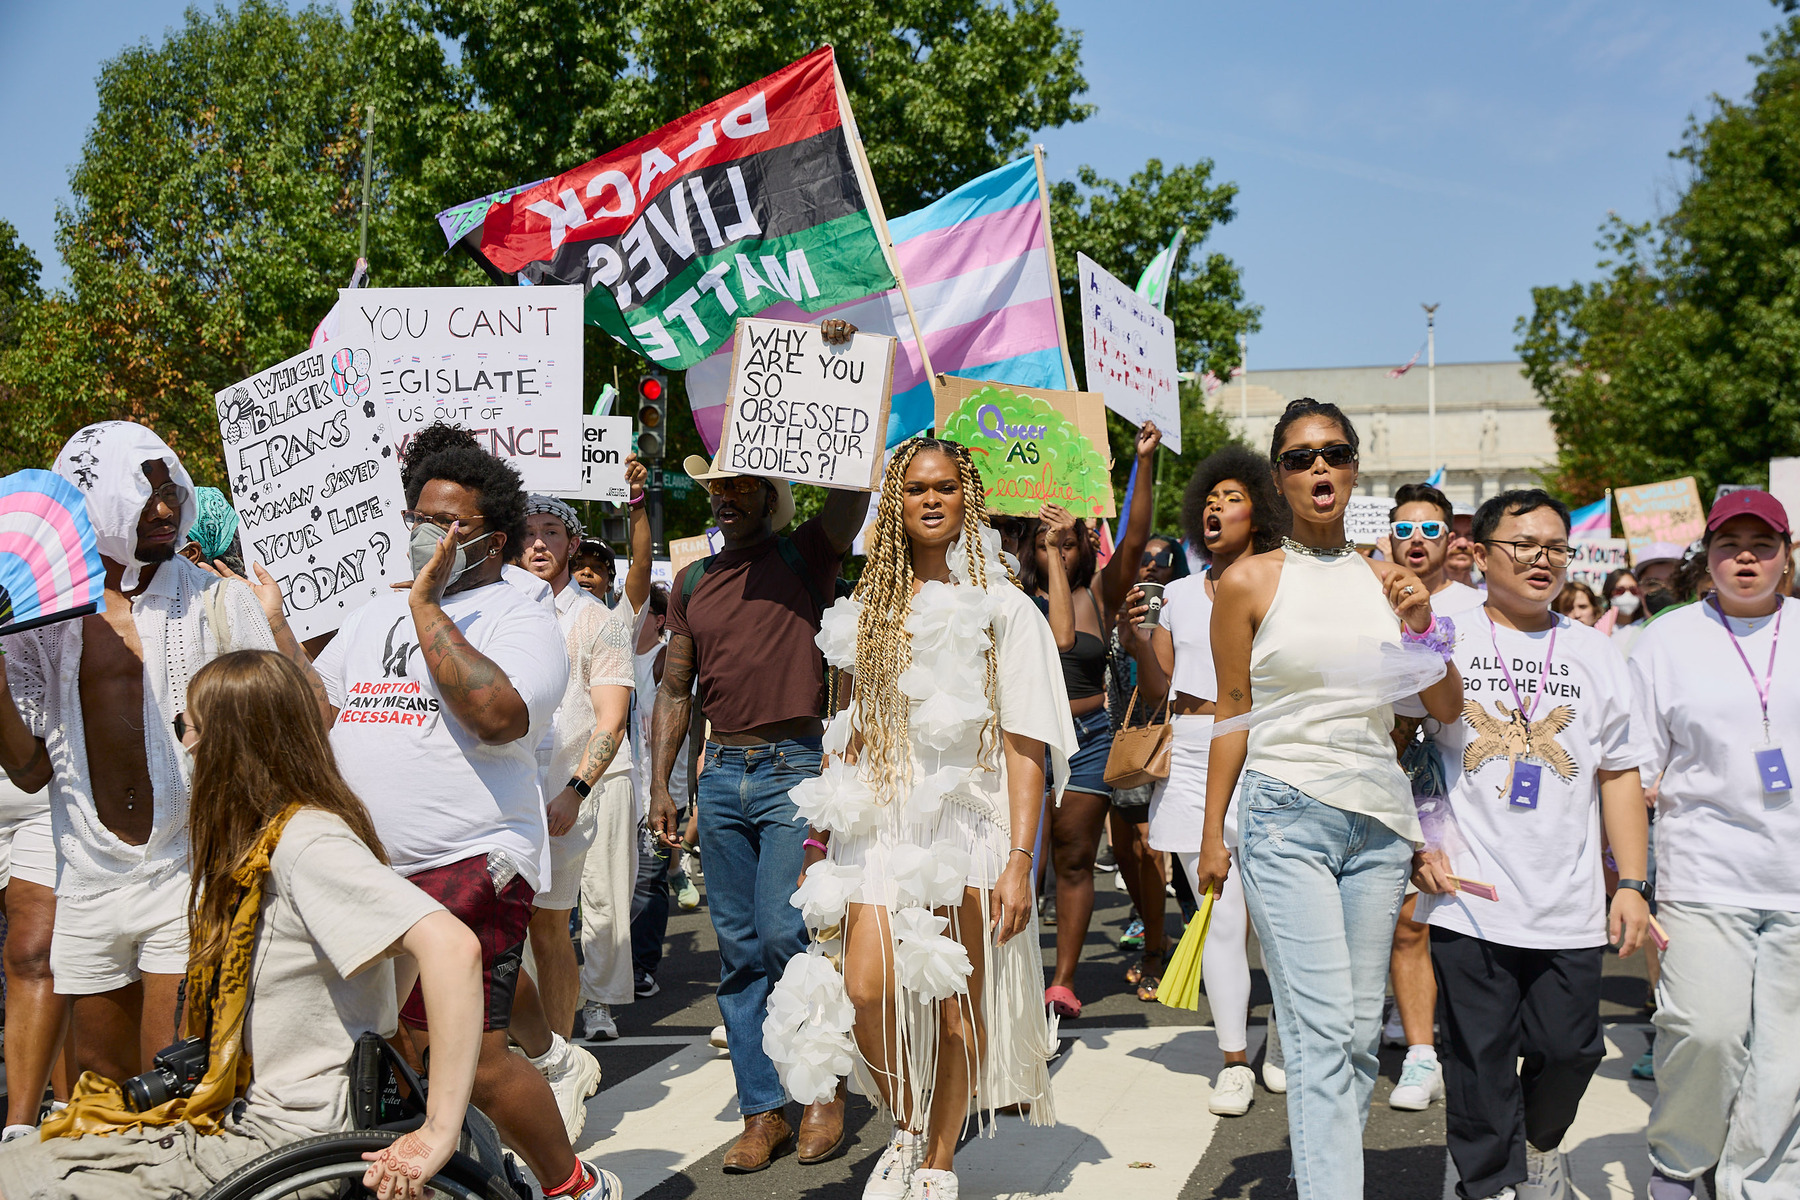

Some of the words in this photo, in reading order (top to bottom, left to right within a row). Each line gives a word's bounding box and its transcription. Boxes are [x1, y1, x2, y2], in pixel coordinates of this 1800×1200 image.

[360, 305, 429, 342] YOU
[448, 304, 558, 339] CAN'T
[748, 325, 808, 354] WHY
[253, 354, 324, 400] WHICH
[744, 349, 804, 374] ARE
[819, 354, 864, 384] YOU
[380, 367, 541, 395] EGISLATE
[743, 371, 782, 398] SO
[252, 380, 333, 436] BLACK
[398, 406, 424, 422] US
[433, 406, 473, 420] OUT
[480, 407, 503, 420] OF
[740, 398, 869, 435] OBSESSED
[583, 422, 607, 442] er
[977, 404, 1047, 444] Queer
[239, 409, 351, 486] TRANS
[582, 444, 619, 464] tion
[736, 421, 803, 450] WITH
[817, 431, 863, 459] OUR
[1005, 441, 1040, 465] AS
[239, 485, 314, 530] WOMAN
[321, 459, 380, 499] SAVED
[663, 473, 693, 490] ELAWARE
[253, 523, 322, 567] YOUR
[327, 495, 384, 536] LIFE
[1470, 656, 1501, 670] ALL
[1512, 658, 1569, 676] DOLLS
[349, 680, 420, 695] ABORTION
[1462, 677, 1481, 691] GO
[1488, 678, 1510, 691] TO
[349, 695, 382, 710] ANY
[382, 695, 440, 712] MEANS
